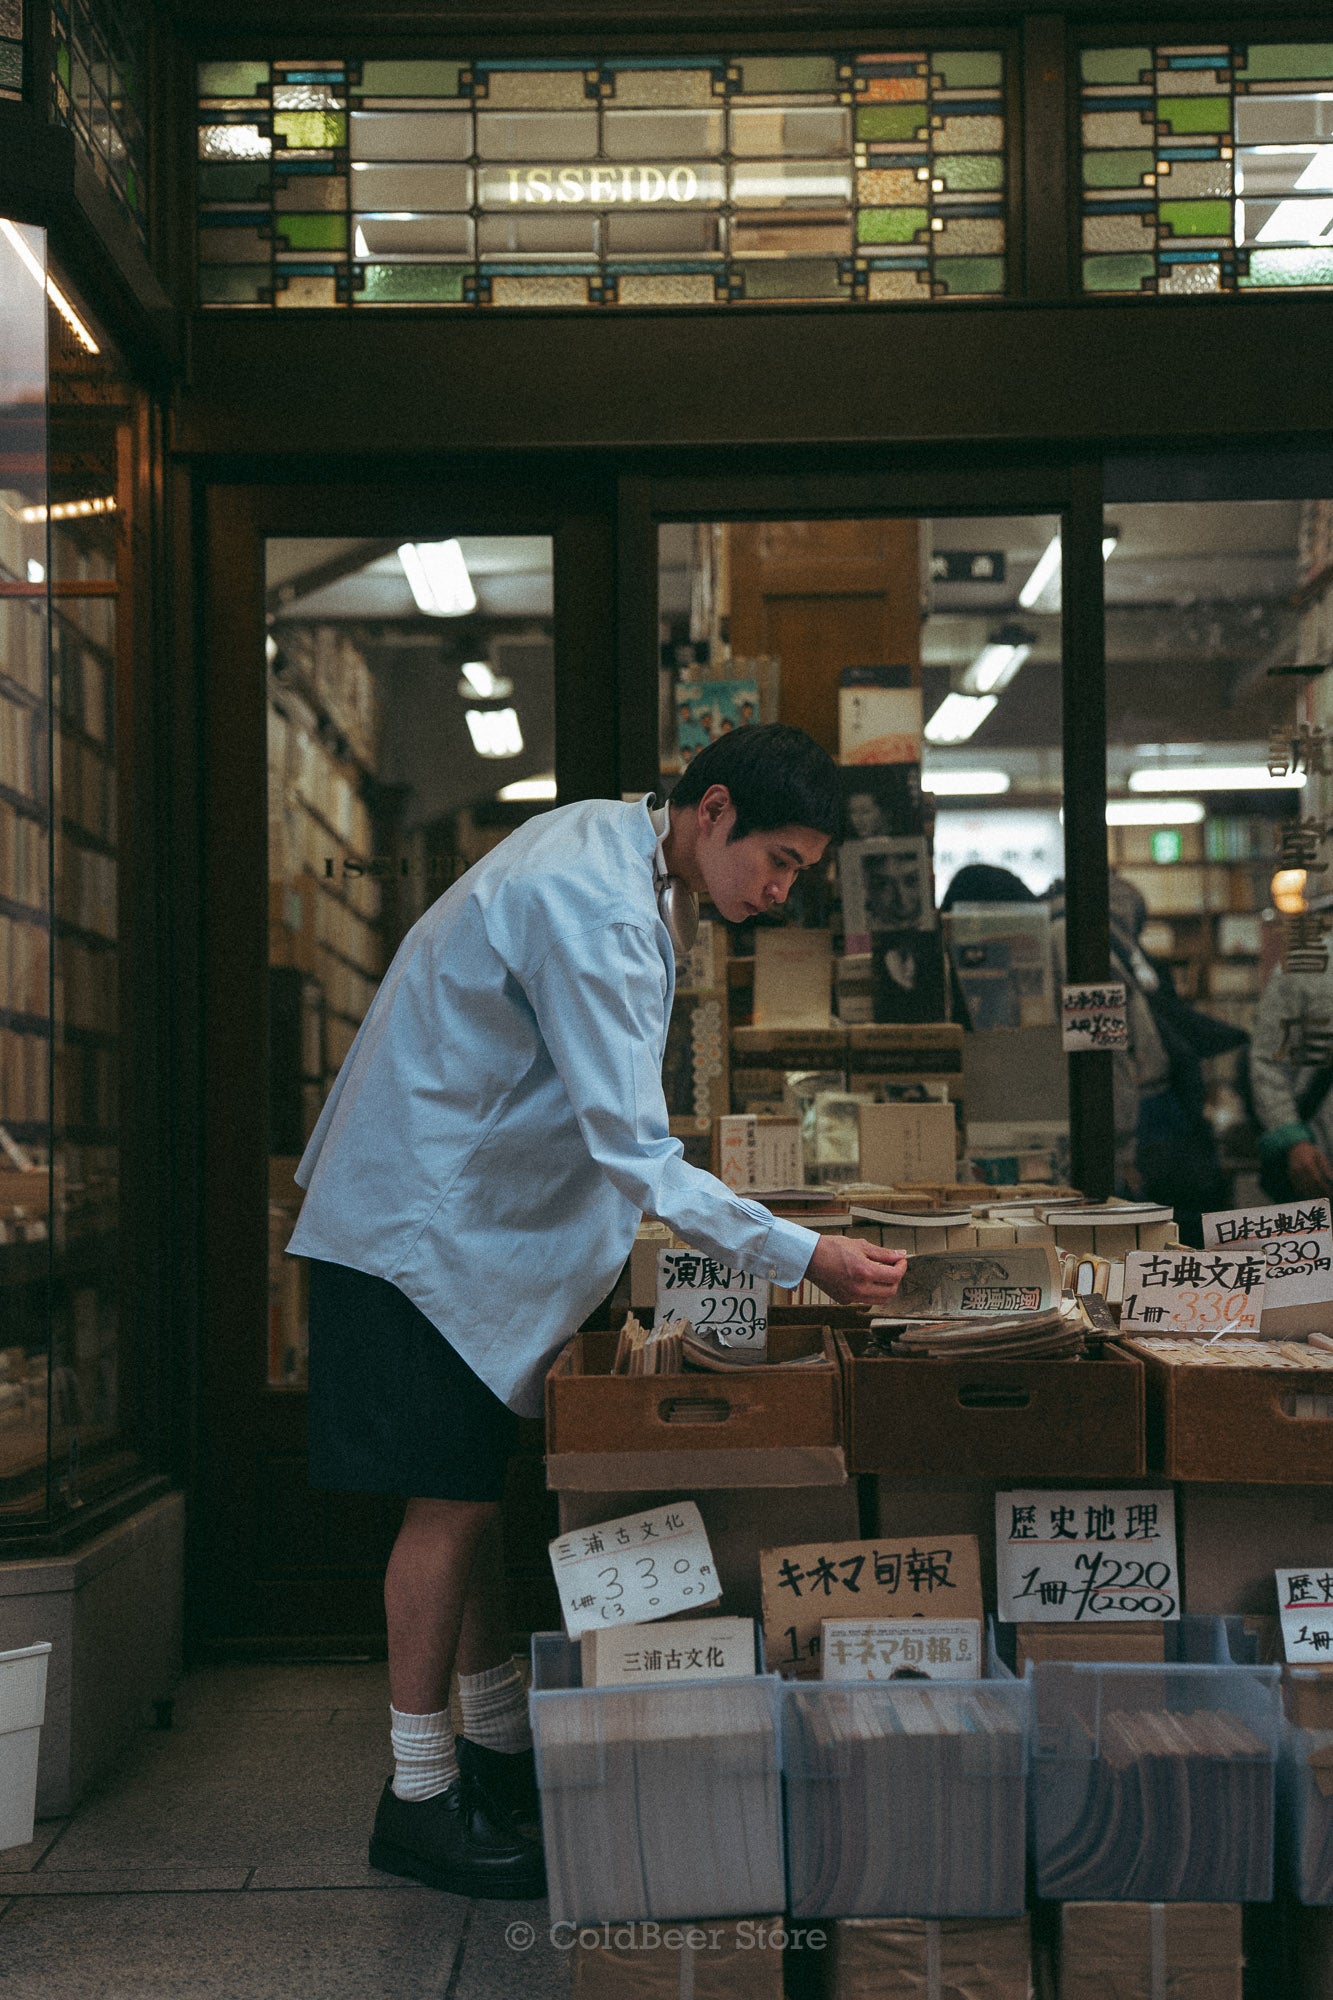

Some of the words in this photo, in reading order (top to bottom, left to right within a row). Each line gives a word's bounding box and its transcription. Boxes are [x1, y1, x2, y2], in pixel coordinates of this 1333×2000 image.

[506, 166, 698, 204] ISSEIDO
[1215, 1205, 1330, 1245] 日本古典全集
[1139, 1254, 1265, 1295] 古典文庫
[1265, 1263, 1313, 1279] (300)
[1121, 1294, 1170, 1323] 1冊
[558, 1513, 685, 1561] 三浦古文化
[778, 1547, 957, 1597] キネマ旬報
[570, 1594, 597, 1612] 1冊
[1088, 1593, 1176, 1618] (200)
[622, 1646, 725, 1673] 三浦古文化
[831, 1636, 952, 1666] キネマ旬報
